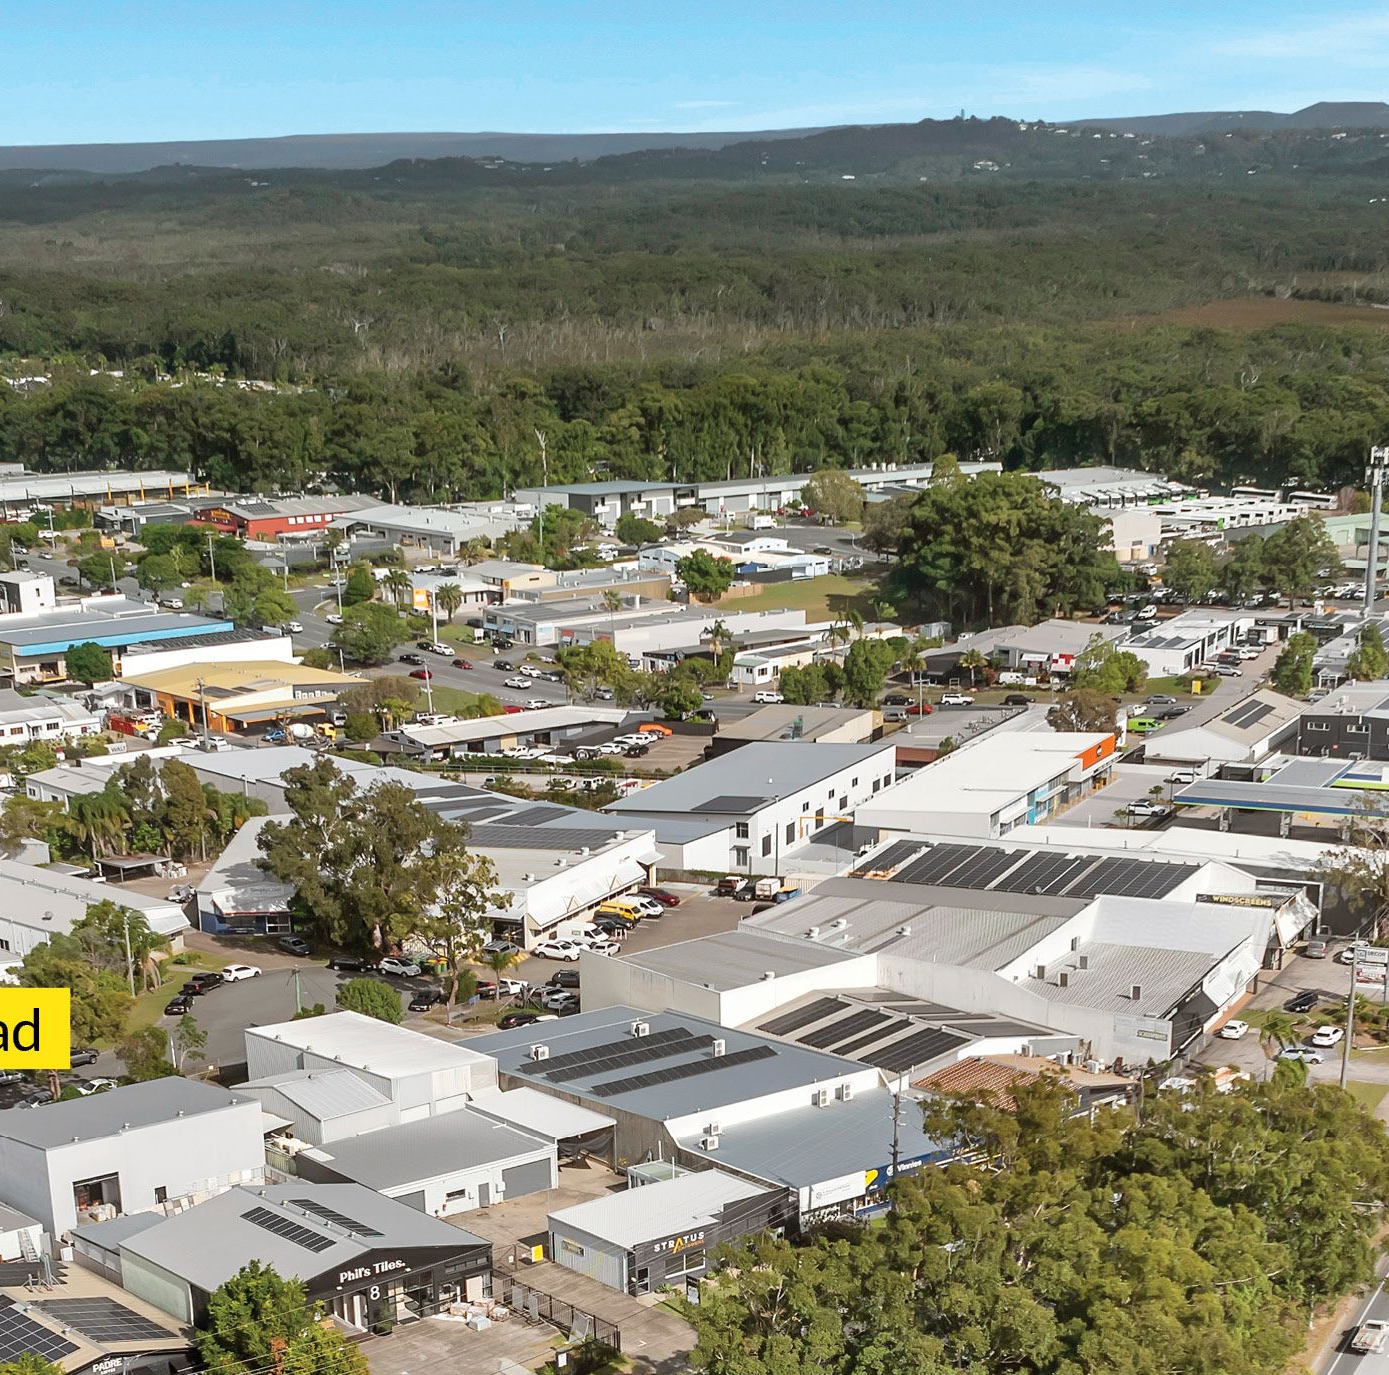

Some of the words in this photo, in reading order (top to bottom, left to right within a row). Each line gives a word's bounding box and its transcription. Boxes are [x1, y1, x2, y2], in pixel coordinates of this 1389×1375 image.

[1212, 895, 1272, 907] WINDSCREENS
[897, 1159, 923, 1173] Vinnies
[653, 1231, 705, 1255] STRATUS
[339, 1266, 372, 1284] Phil's
[370, 1285, 381, 1301] 8
